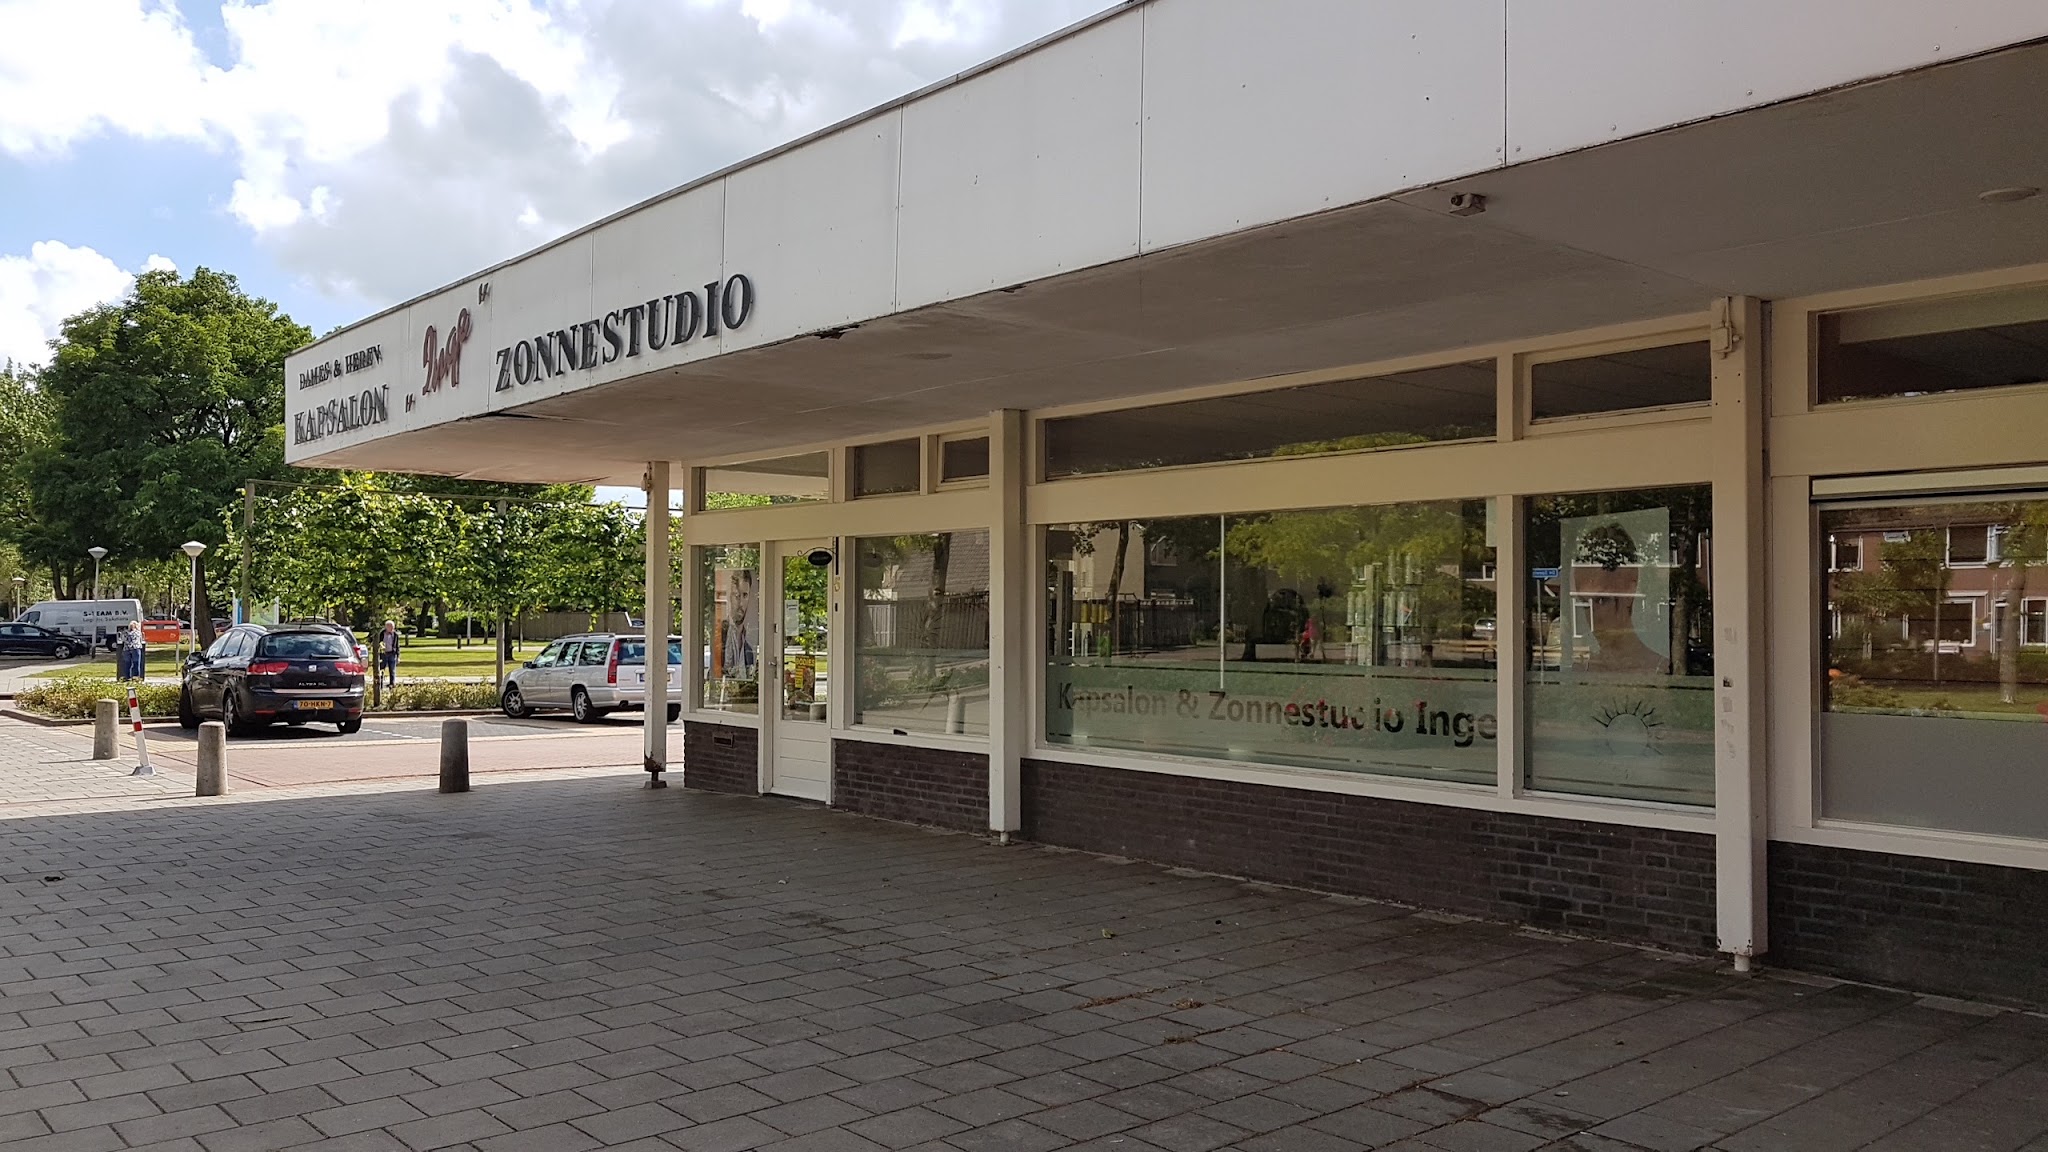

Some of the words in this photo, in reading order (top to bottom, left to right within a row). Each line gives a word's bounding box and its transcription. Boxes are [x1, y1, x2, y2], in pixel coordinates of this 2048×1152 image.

[495, 273, 753, 392] ZONNESTUDIO
[299, 361, 331, 390] DAMES
[333, 359, 341, 378] &
[345, 344, 382, 374] HEREN
[294, 384, 389, 446] KAPSALON
[1059, 683, 1167, 721] Kapsalon
[1177, 690, 1199, 719] &
[1416, 701, 1498, 748] Inge
